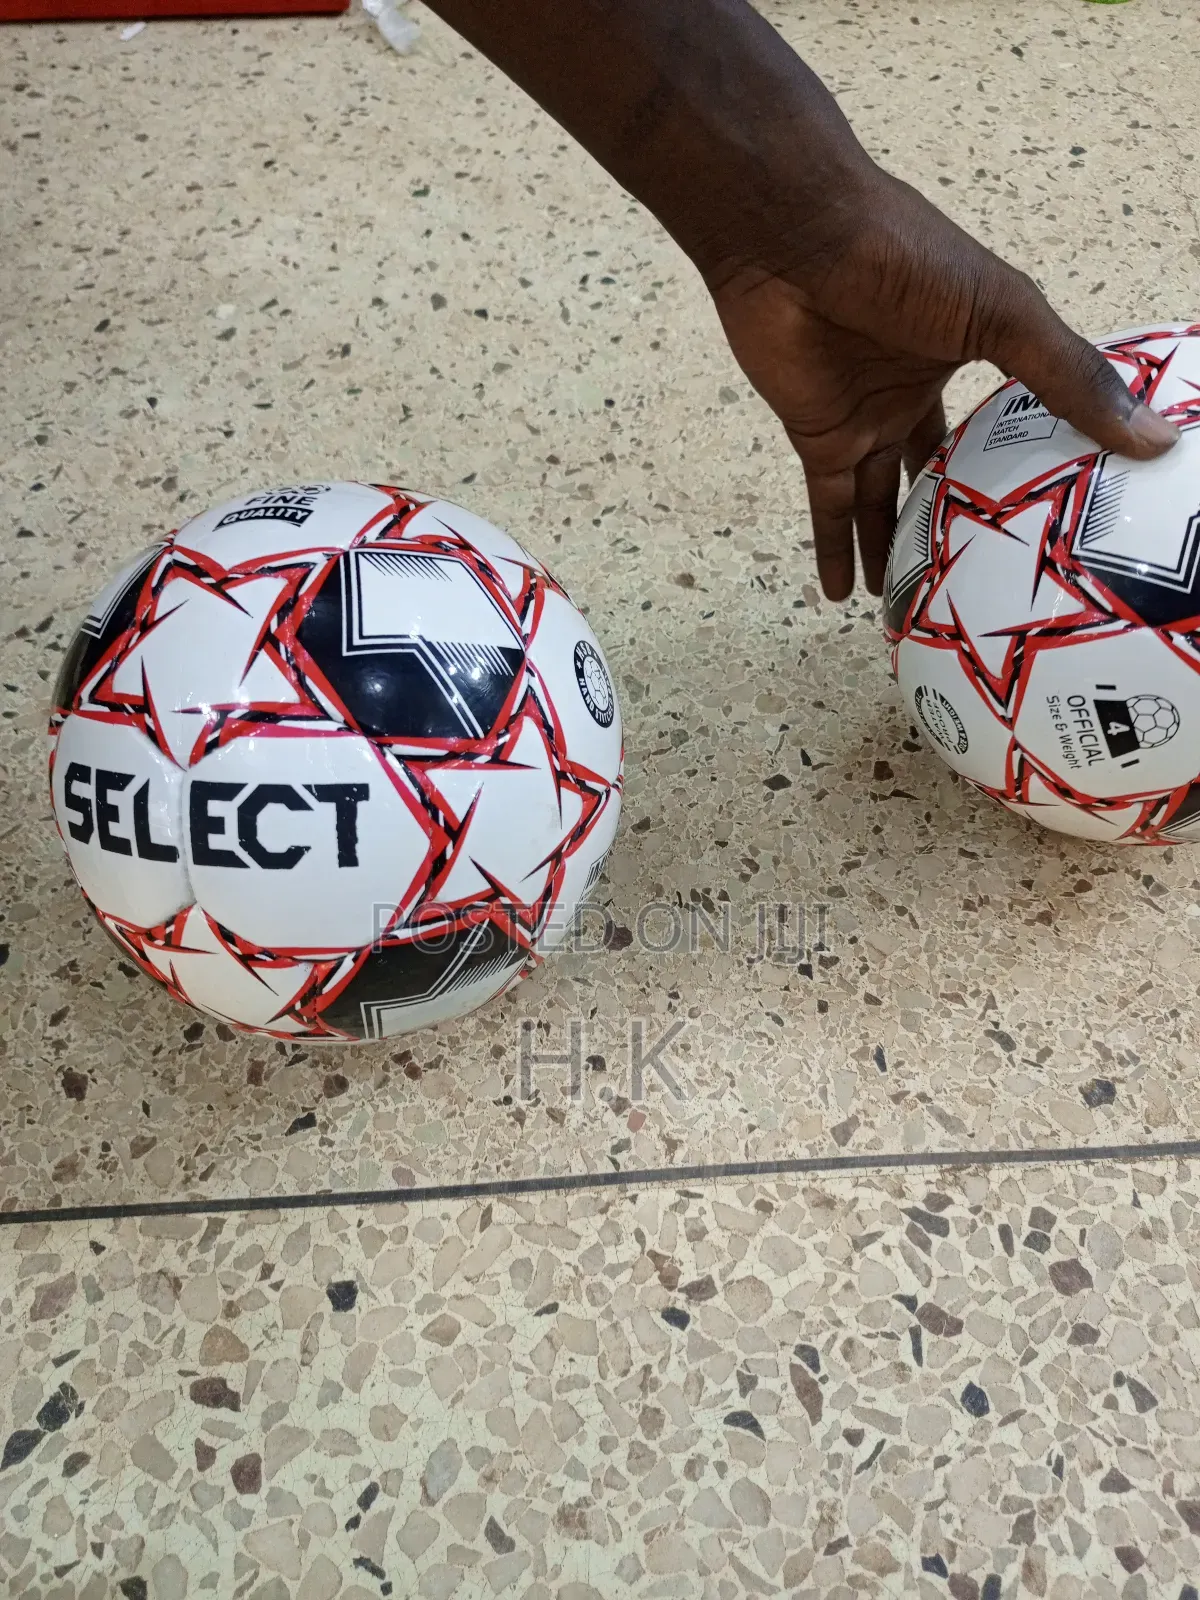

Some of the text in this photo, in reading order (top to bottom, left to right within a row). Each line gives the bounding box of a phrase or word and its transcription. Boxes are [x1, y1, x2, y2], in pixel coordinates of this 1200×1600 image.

[1003, 395, 1041, 417] IM
[996, 411, 1051, 428] INTERNATION
[988, 431, 1028, 446] STANDARD
[992, 425, 1019, 437] MATCH
[244, 495, 318, 506] FINE
[221, 507, 310, 524] QUALITY
[578, 677, 595, 712] HAND
[1046, 695, 1062, 720] Size
[1059, 734, 1083, 769] Weight
[1066, 695, 1105, 767] OFFICIAL
[1107, 721, 1131, 736] 4
[64, 761, 370, 870] SELECT
